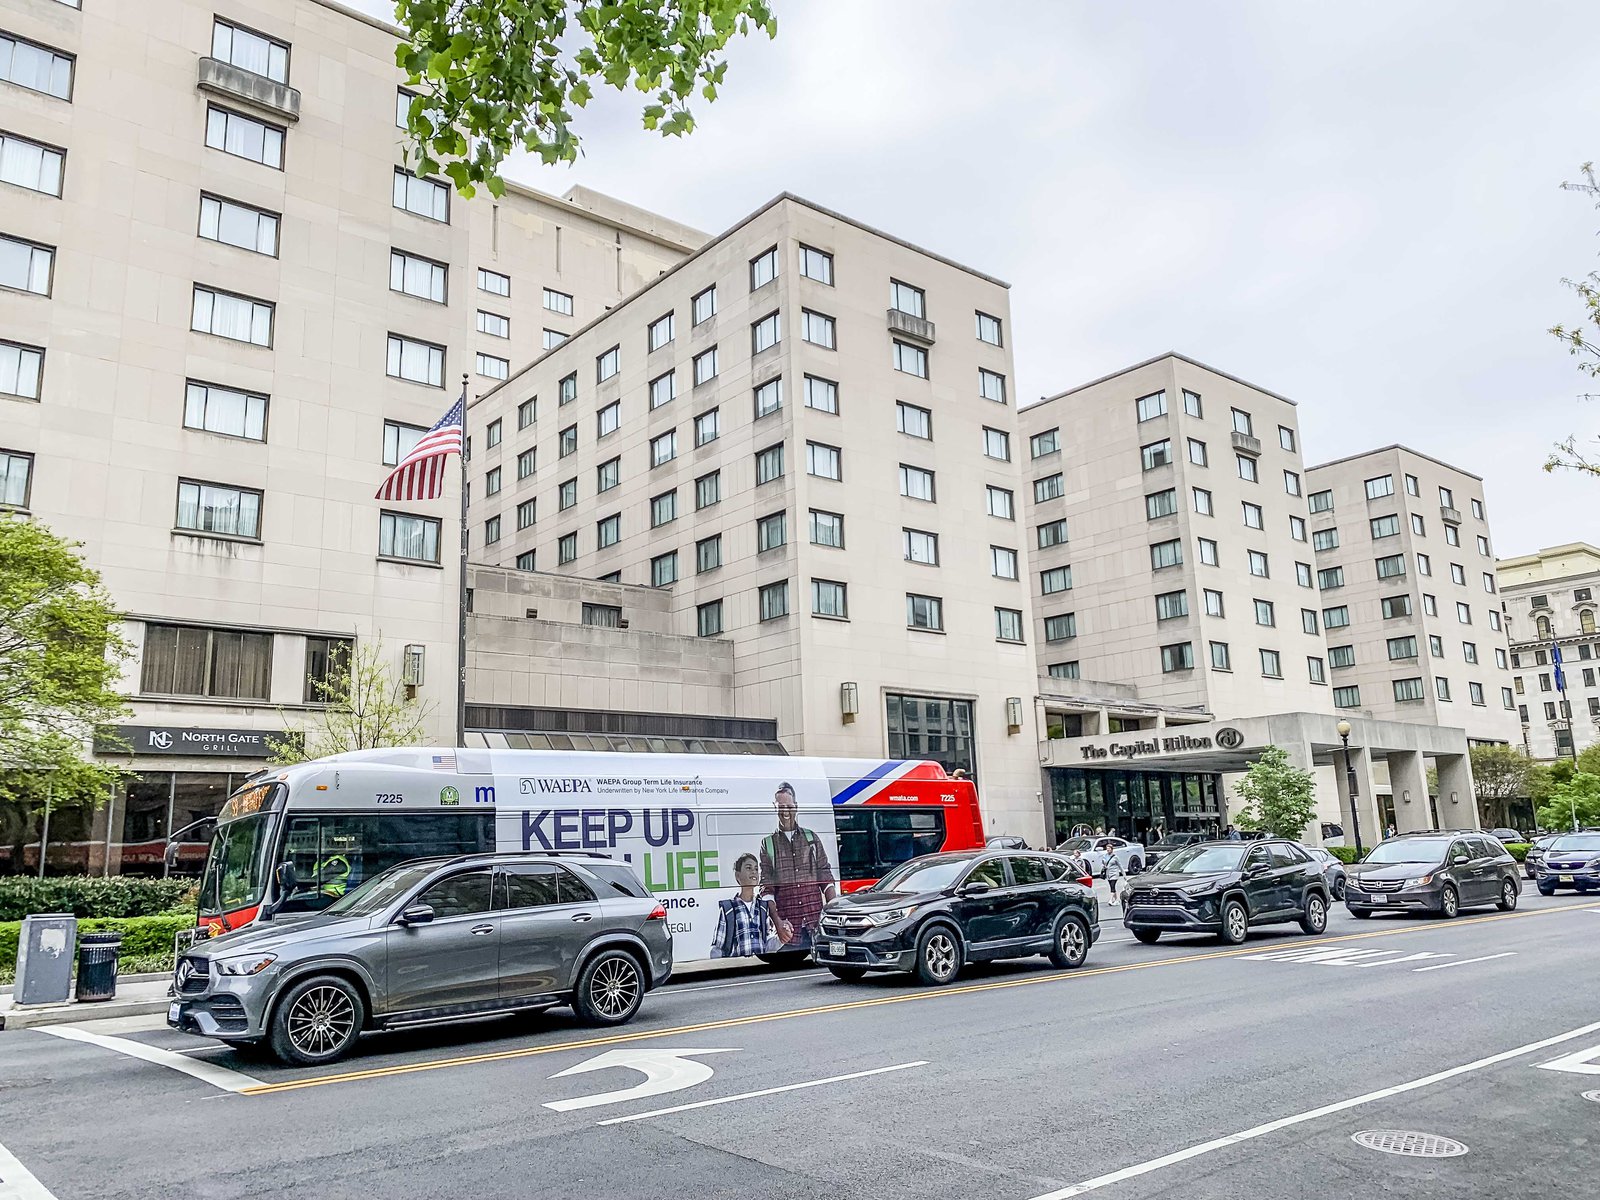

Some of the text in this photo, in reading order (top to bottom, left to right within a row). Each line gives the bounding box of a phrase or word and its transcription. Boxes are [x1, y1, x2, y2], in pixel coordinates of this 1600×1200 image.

[182, 732, 259, 744] NORTH GATE
[203, 744, 238, 752] GRILL
[1080, 735, 1212, 759] The Capital Hilton
[622, 778, 642, 786] Group
[634, 787, 641, 795] by
[705, 787, 729, 795] Company
[376, 794, 403, 804] 7225
[889, 794, 919, 802] wmata.com
[521, 808, 695, 850] KEEP UP
[644, 851, 720, 892] LIFE
[659, 897, 699, 909] ance.
